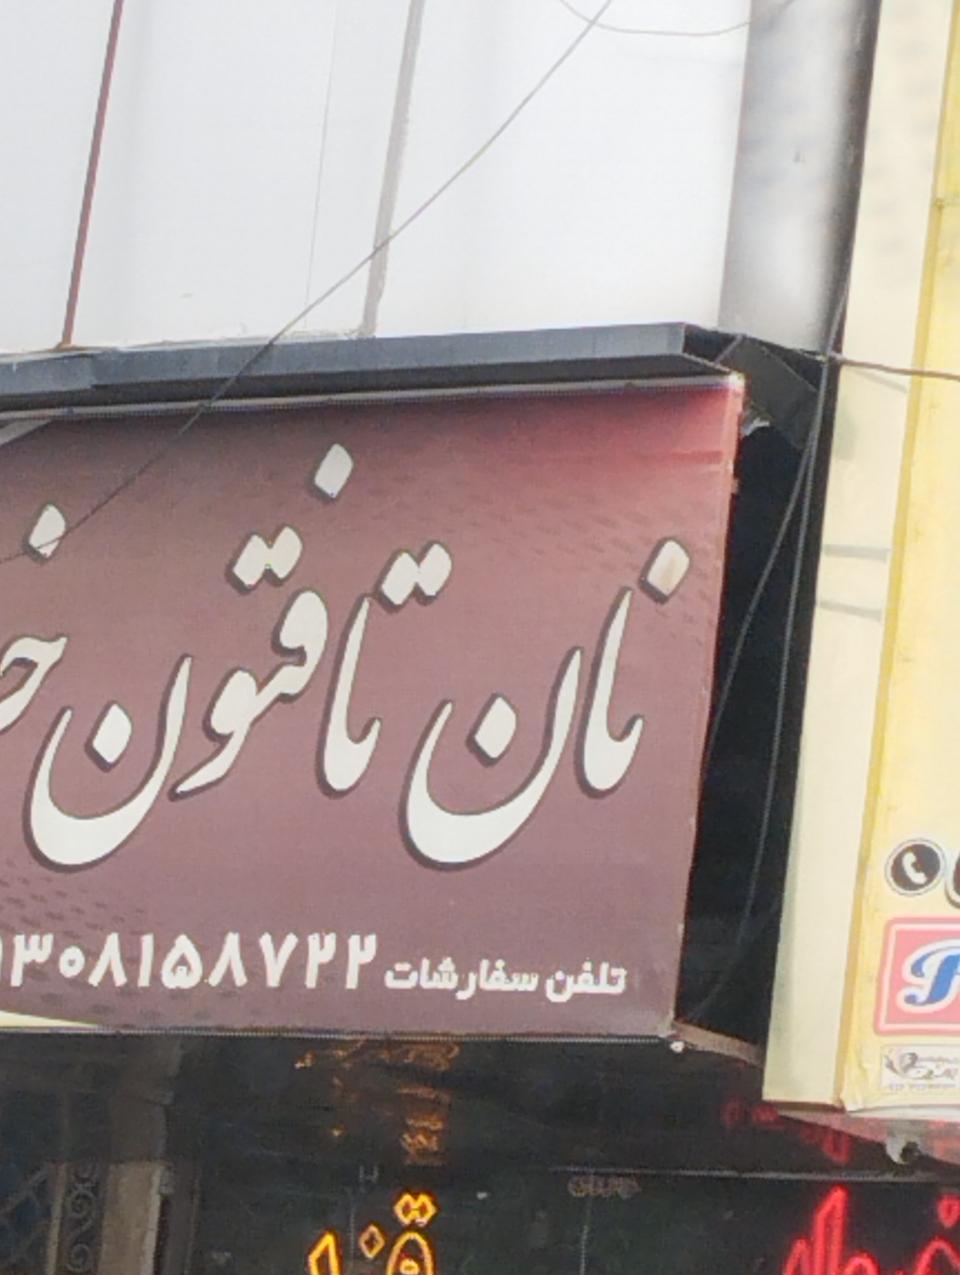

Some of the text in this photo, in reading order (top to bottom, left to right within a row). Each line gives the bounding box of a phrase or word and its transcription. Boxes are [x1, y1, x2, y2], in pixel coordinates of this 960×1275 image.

[27, 443, 453, 866] تافتون
[405, 538, 691, 866] نان
[384, 956, 539, 1000] سفارشات
[545, 957, 628, 1002] تلفن
